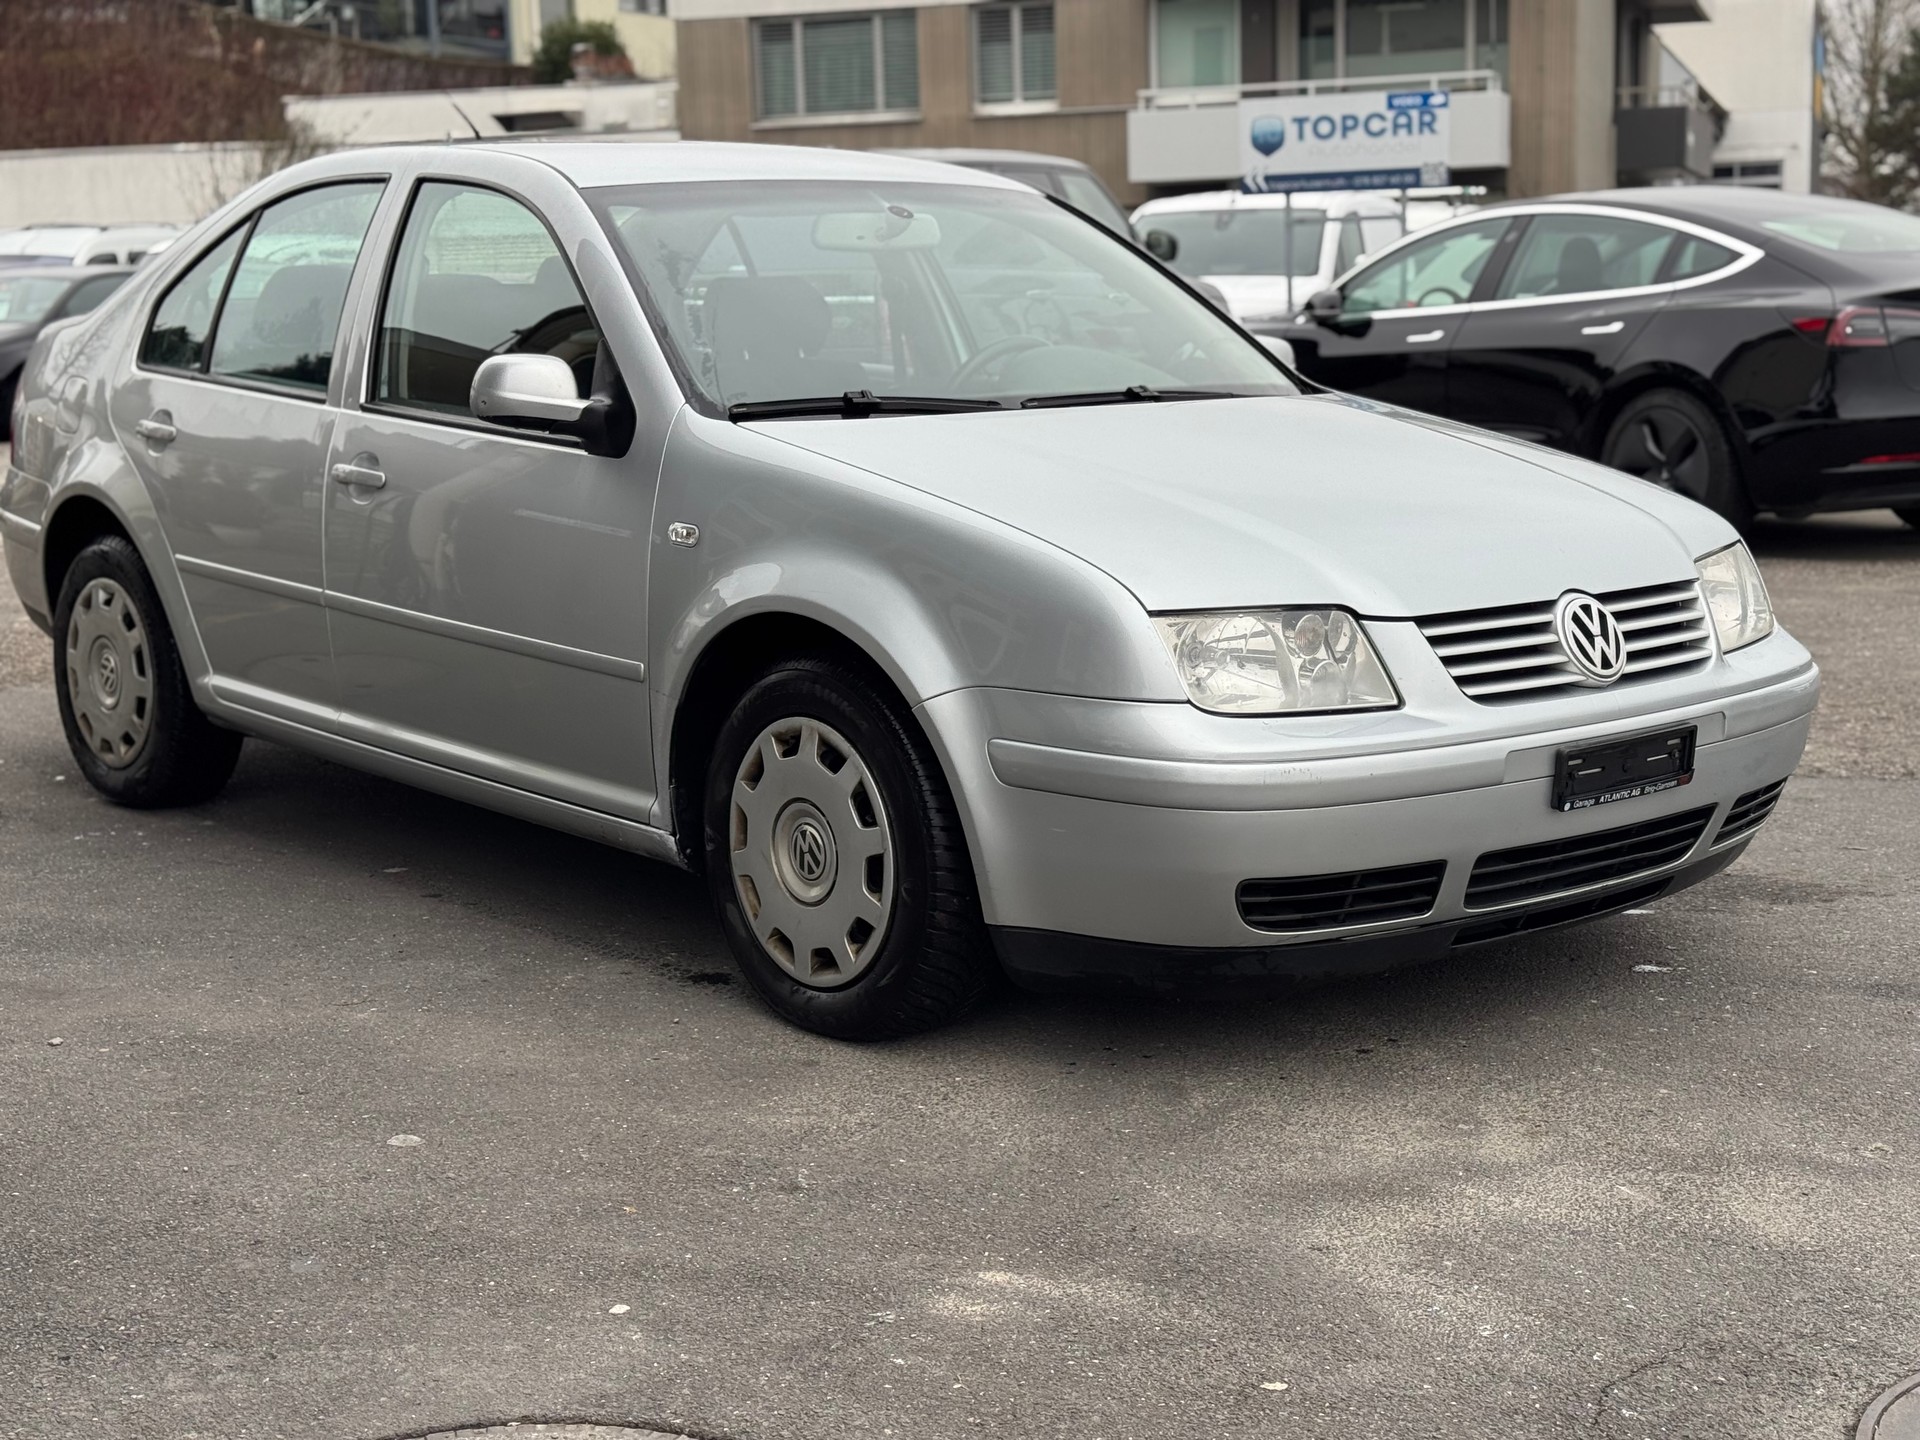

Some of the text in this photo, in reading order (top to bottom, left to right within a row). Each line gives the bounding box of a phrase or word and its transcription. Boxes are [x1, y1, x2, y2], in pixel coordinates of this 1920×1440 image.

[1292, 111, 1437, 141] TOPCAR
[1567, 599, 1624, 675] VW
[1573, 799, 1596, 808] Garage
[1599, 789, 1631, 803] ATLANTIC
[1631, 787, 1641, 797] AG
[792, 824, 825, 878] VW
